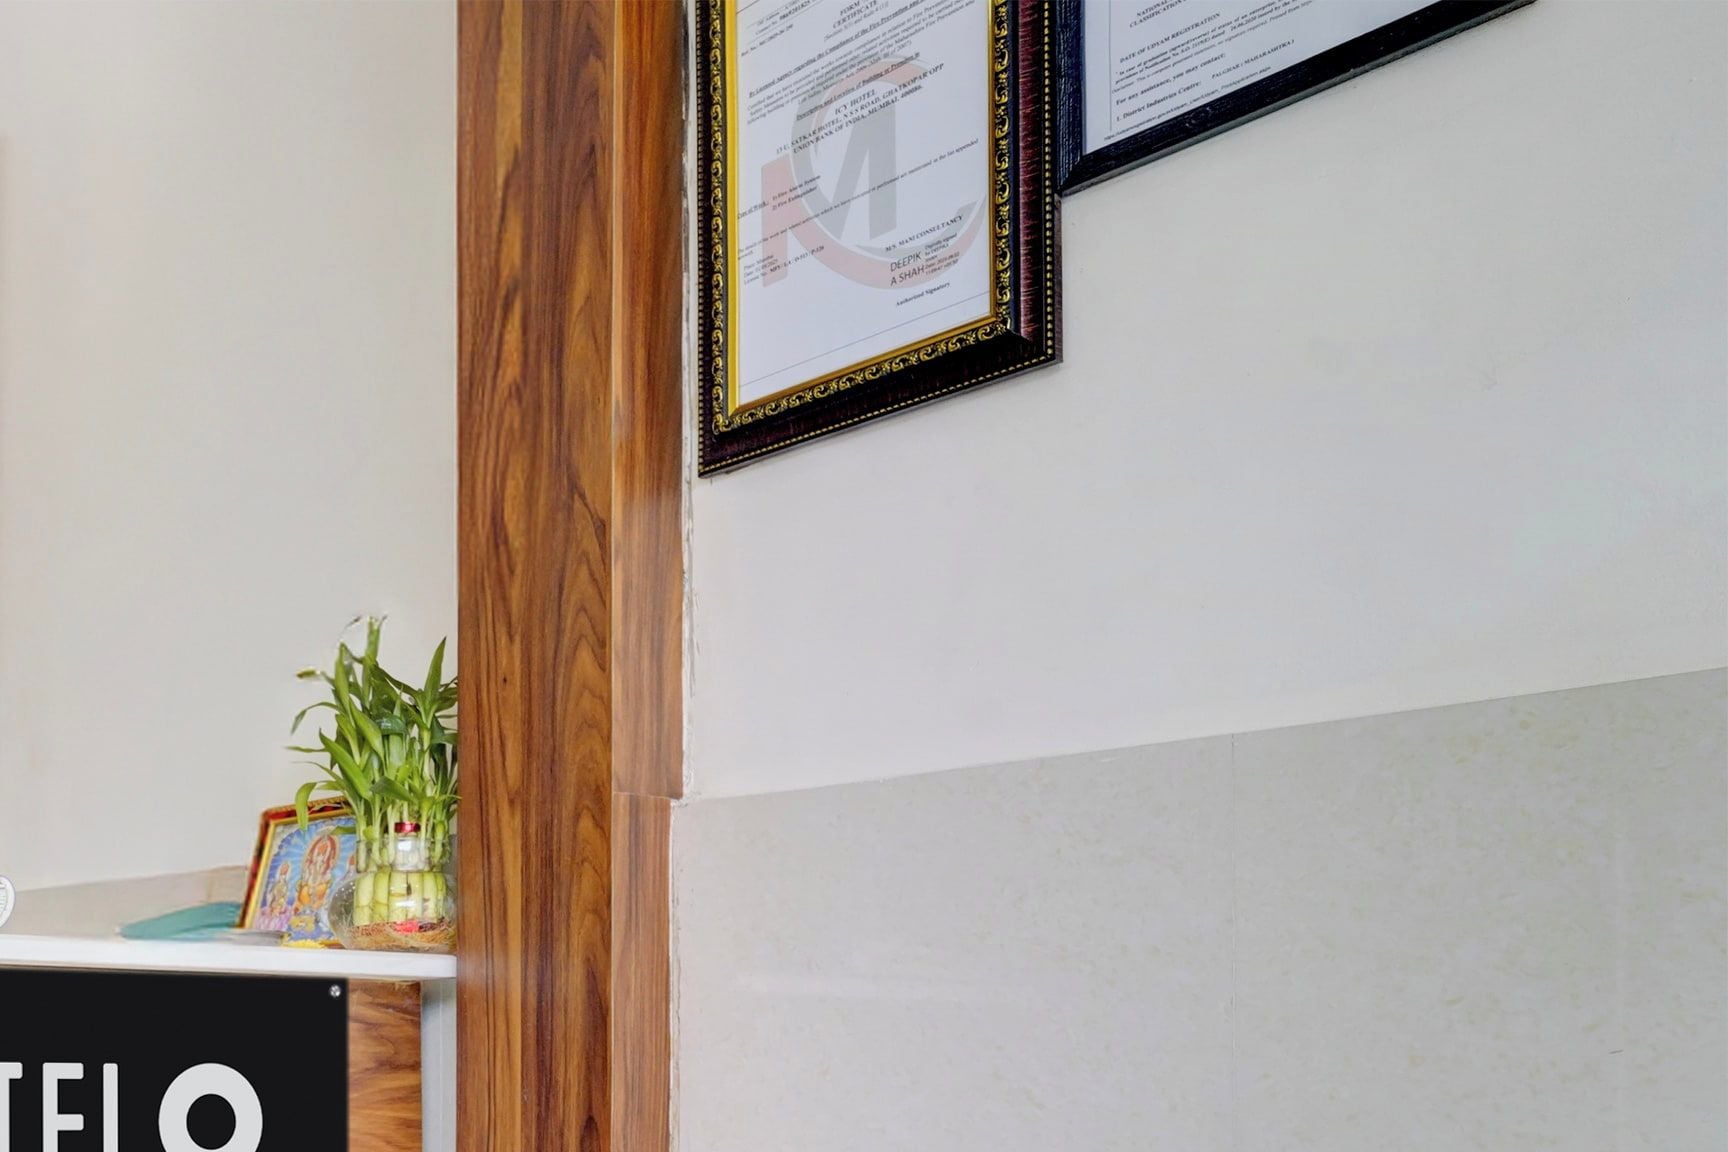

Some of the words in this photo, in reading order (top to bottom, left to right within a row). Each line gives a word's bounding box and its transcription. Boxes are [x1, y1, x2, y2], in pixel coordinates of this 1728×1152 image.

[850, 89, 875, 107] HOTEL
[890, 251, 922, 272] DEEPIK
[890, 275, 898, 287] A
[898, 264, 925, 283] SHAH
